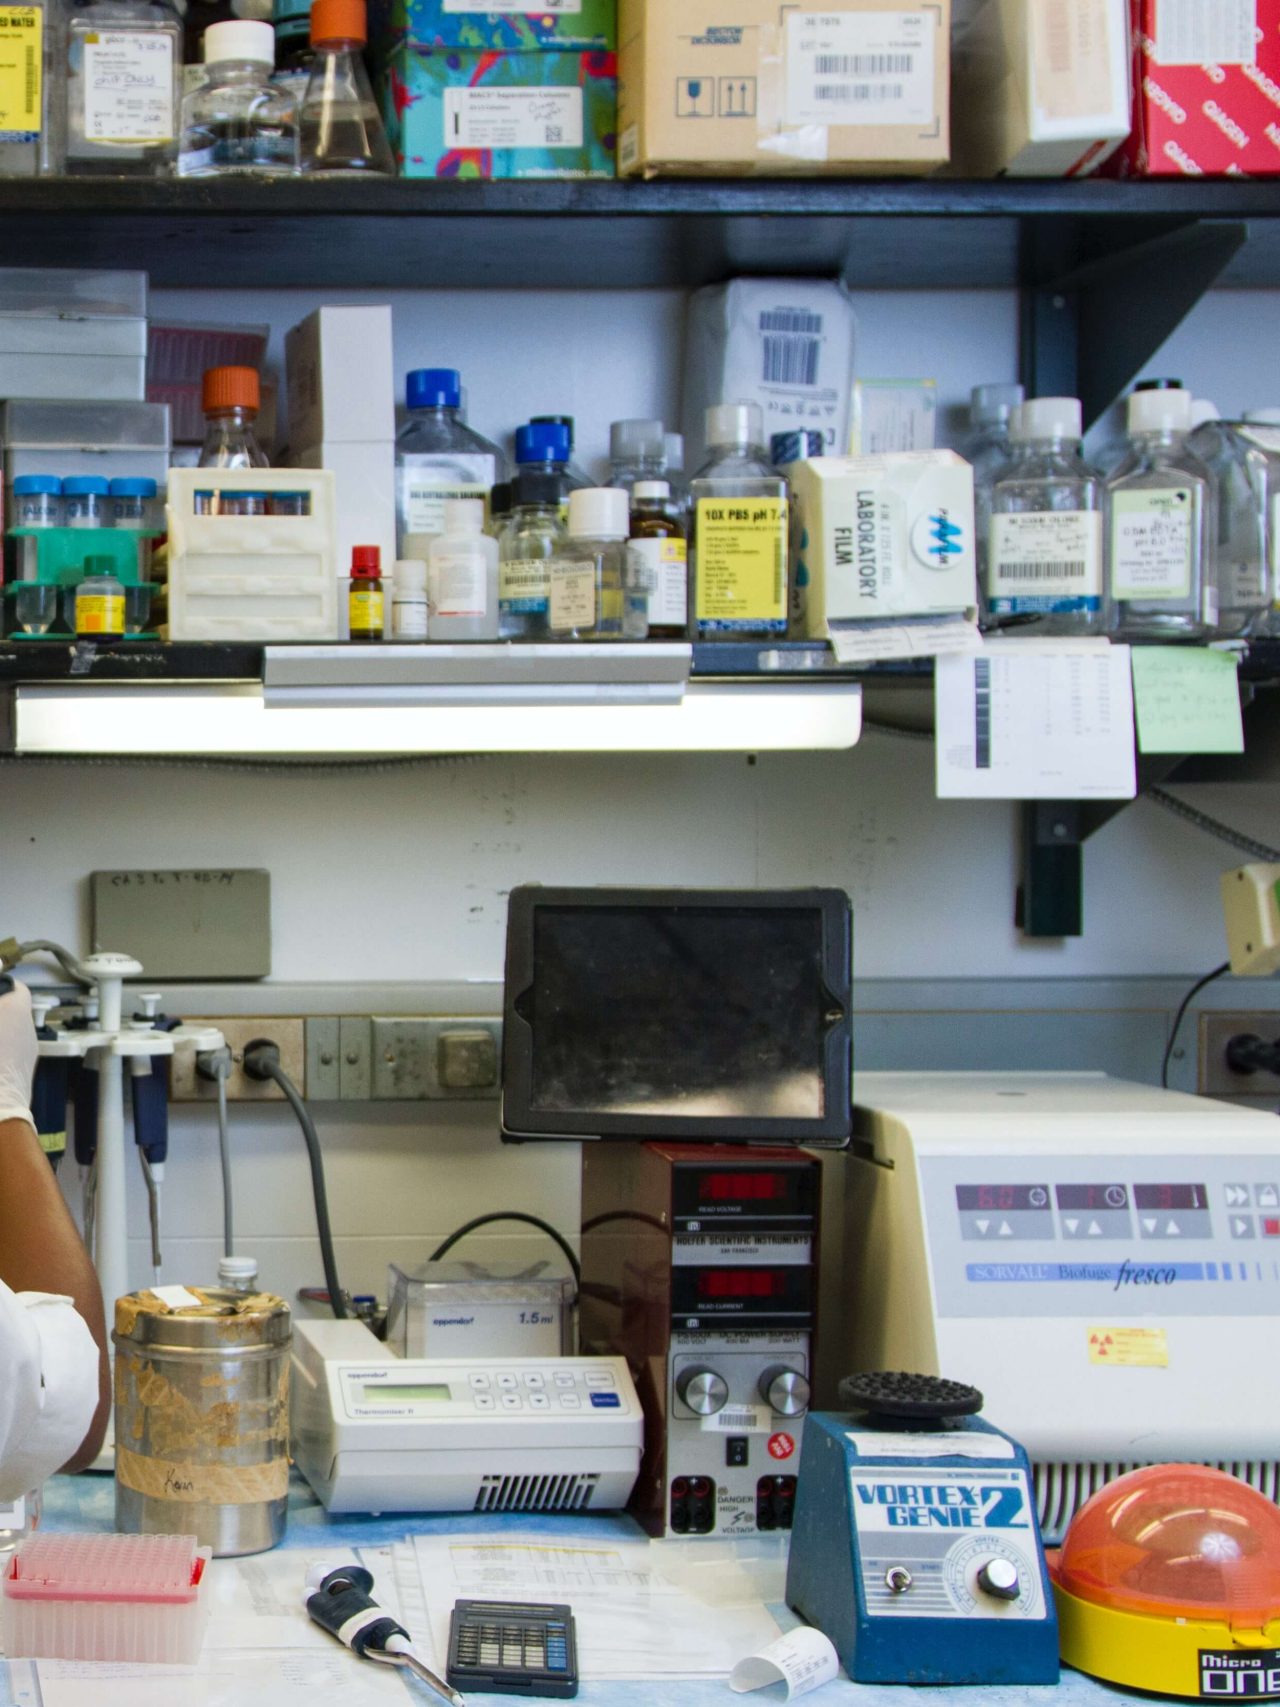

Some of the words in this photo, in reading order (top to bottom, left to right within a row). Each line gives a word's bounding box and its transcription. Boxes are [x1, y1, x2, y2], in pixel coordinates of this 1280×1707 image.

[11, 17, 35, 27] WATER
[1202, 100, 1250, 148] QIAGEN
[706, 510, 725, 520] 10X
[728, 510, 749, 520] PBS
[753, 510, 768, 523] pH
[770, 509, 787, 520] 7.4
[835, 527, 854, 566] FILM
[856, 490, 878, 600] LABORATORY
[710, 1235, 751, 1245] SCIENTIFIC
[755, 1234, 809, 1245] INSTRUMENTS
[1059, 1264, 1111, 1281] Biofuge
[1114, 1258, 1177, 1291] fresco
[432, 1316, 475, 1328] eppendorf
[519, 1313, 540, 1325] 1.5
[541, 1314, 554, 1325] ml
[348, 1372, 388, 1380] eppendorf
[718, 1496, 754, 1504] DANGER
[980, 1486, 1029, 1529] 2
[887, 1506, 981, 1528] GENIE
[1202, 1654, 1262, 1668] Micro
